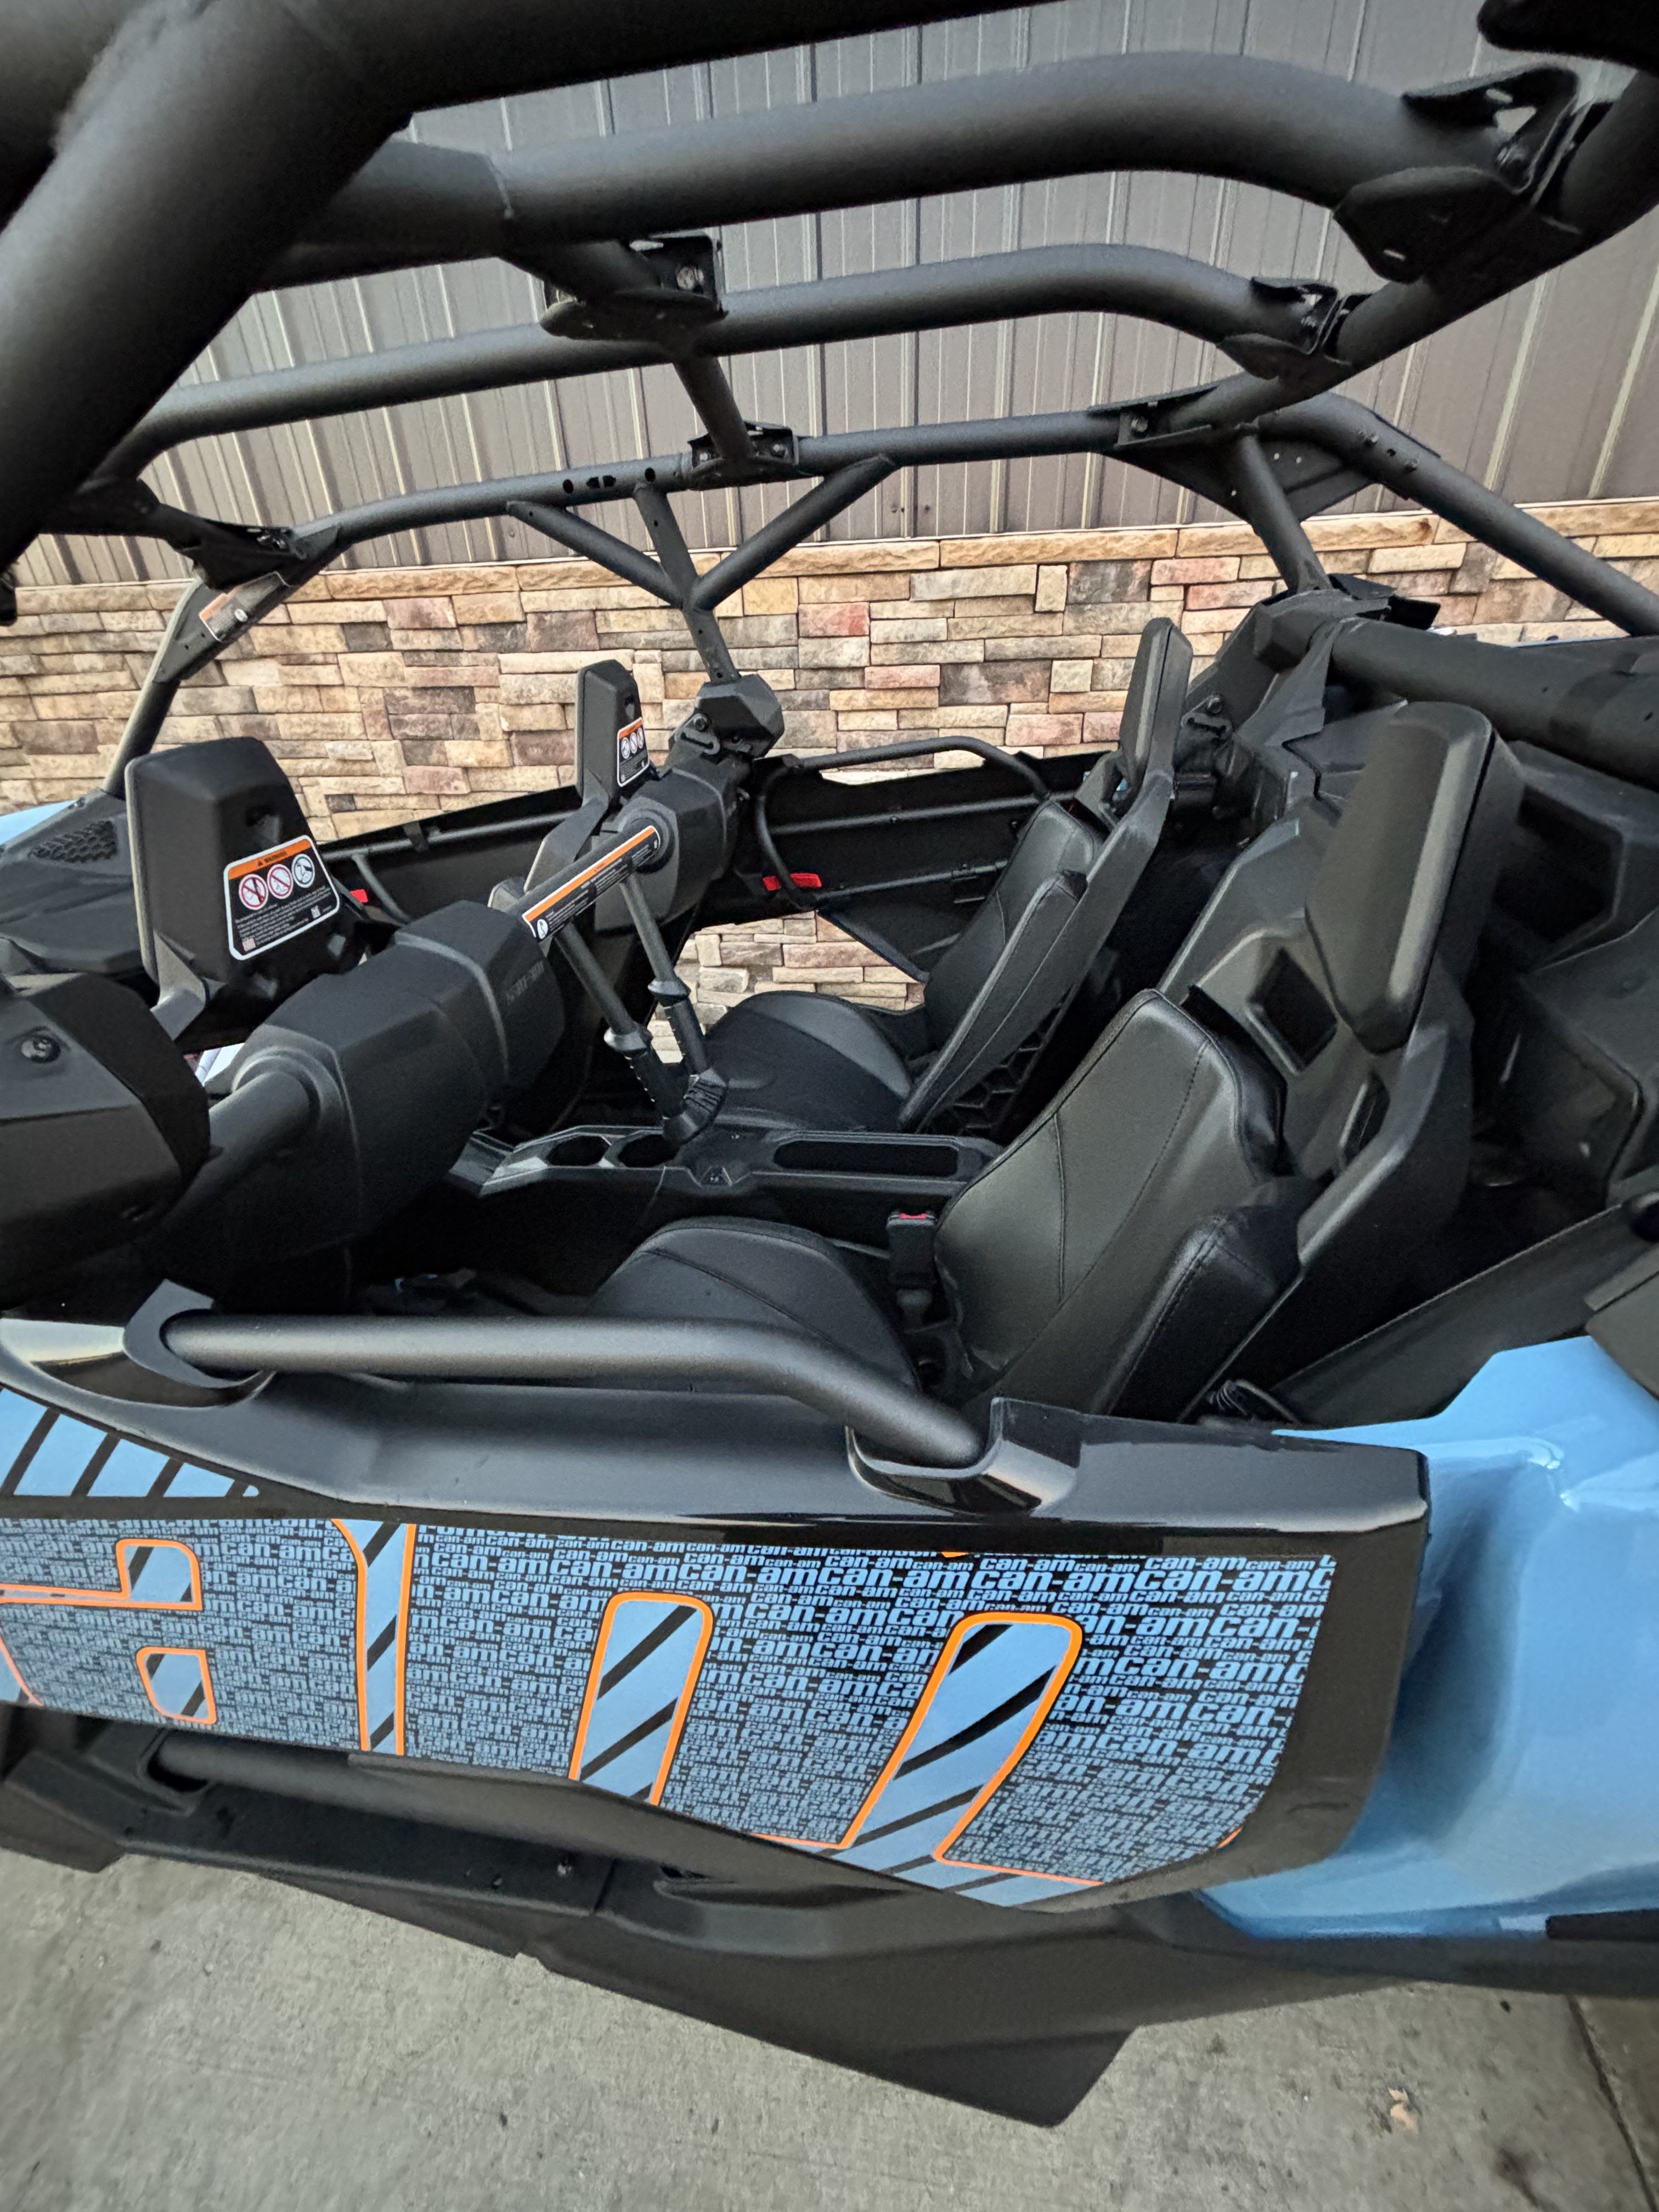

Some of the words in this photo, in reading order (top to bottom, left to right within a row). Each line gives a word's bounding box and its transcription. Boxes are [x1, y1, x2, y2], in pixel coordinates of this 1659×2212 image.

[221, 1534, 280, 1544] can-am
[265, 1526, 321, 1537] can-am
[221, 1543, 320, 1561] can-am
[486, 1536, 554, 1549] can-am
[555, 1540, 610, 1549] can-am
[611, 1540, 685, 1553] can-am
[686, 1543, 744, 1553] can-am
[223, 1556, 277, 1566] can-am
[434, 1543, 502, 1556] can-am
[502, 1550, 549, 1560] can-am
[554, 1549, 628, 1562] can-am
[628, 1555, 680, 1565] can-am
[683, 1552, 765, 1566] can-am
[765, 1558, 821, 1568] can-am
[825, 1556, 913, 1570] can-am
[913, 1561, 974, 1571] can-am
[980, 1558, 1075, 1571] can-am
[1074, 1564, 1139, 1572] can-am
[1144, 1558, 1246, 1570] can-am
[1245, 1560, 1315, 1570] can-am
[202, 1570, 276, 1589] an-am
[278, 1575, 356, 1593] can-a
[278, 1566, 337, 1579] can-am
[432, 1553, 548, 1573] can-am
[550, 1559, 678, 1581] can-am
[678, 1564, 819, 1585] can-am
[817, 1567, 970, 1589] can-am
[972, 1571, 1135, 1592] can-am
[1134, 1570, 1310, 1592] can-am
[432, 1567, 494, 1580] can-am
[496, 1572, 546, 1582] can-am
[549, 1575, 618, 1588] can-am
[619, 1579, 675, 1589] can-am
[676, 1580, 753, 1593] can-am
[754, 1584, 814, 1594] can-am
[815, 1585, 898, 1598] can-am
[899, 1588, 964, 1598] can-am
[967, 1589, 1056, 1602] can-am
[1058, 1592, 1128, 1602] can-am
[1129, 1591, 1225, 1603] can-am
[1227, 1592, 1302, 1602] can-am
[447, 1579, 491, 1589] can-am
[494, 1579, 563, 1594] can-am
[563, 1588, 612, 1597] can-am
[443, 1599, 490, 1611] can-am
[492, 1603, 555, 1617] can-am
[492, 1589, 606, 1612] can-am
[751, 1593, 833, 1606] can-am
[833, 1599, 891, 1610] can-am
[895, 1597, 984, 1611] can-am
[1052, 1602, 1149, 1616] can-am
[1149, 1607, 1214, 1617] can-am
[1220, 1604, 1324, 1617] can-am
[237, 1600, 333, 1621] can-am
[442, 1607, 506, 1622] can-am
[506, 1616, 551, 1627] can-am
[744, 1603, 888, 1626] can-am
[198, 1624, 290, 1643] can-am
[439, 1615, 550, 1638] can-am
[743, 1619, 820, 1633] can-am
[822, 1624, 883, 1634] can-am
[884, 1624, 949, 1637] can-a
[1077, 1615, 1209, 1635] an-am
[440, 1628, 500, 1641] can-am
[760, 1633, 813, 1642] can-am
[817, 1632, 902, 1646] can-am
[1129, 1635, 1203, 1646] can-am
[1205, 1637, 1304, 1650] can-am
[409, 1642, 498, 1661] an-am
[501, 1641, 568, 1656] can-am
[1124, 1646, 1223, 1659] can-am
[1222, 1651, 1290, 1662] can-am
[254, 1650, 347, 1672] can-am
[499, 1662, 561, 1675] can-am
[749, 1653, 808, 1666] can-am
[809, 1656, 886, 1671] can-am
[1114, 1657, 1285, 1681] can-am
[451, 1664, 514, 1677] can-am
[746, 1663, 826, 1677] can-am
[826, 1671, 881, 1682] can-am
[450, 1671, 556, 1694] can-am
[741, 1671, 877, 1696] can-am
[1109, 1674, 1203, 1689] can-am
[1204, 1679, 1277, 1691] can-am
[740, 1685, 815, 1700] can-am
[1127, 1691, 1192, 1701] can-am
[1198, 1691, 1299, 1708] can-am
[407, 1691, 506, 1713] can-am
[811, 1700, 892, 1716] can-am
[1056, 1695, 1186, 1720] an-am
[1105, 1724, 1201, 1742] can-am
[1182, 1720, 1283, 1737] can-am
[741, 1728, 870, 1752] can-am
[1096, 1733, 1261, 1765] can-am
[679, 1744, 801, 1768] can-am
[1092, 1749, 1180, 1765] can-am
